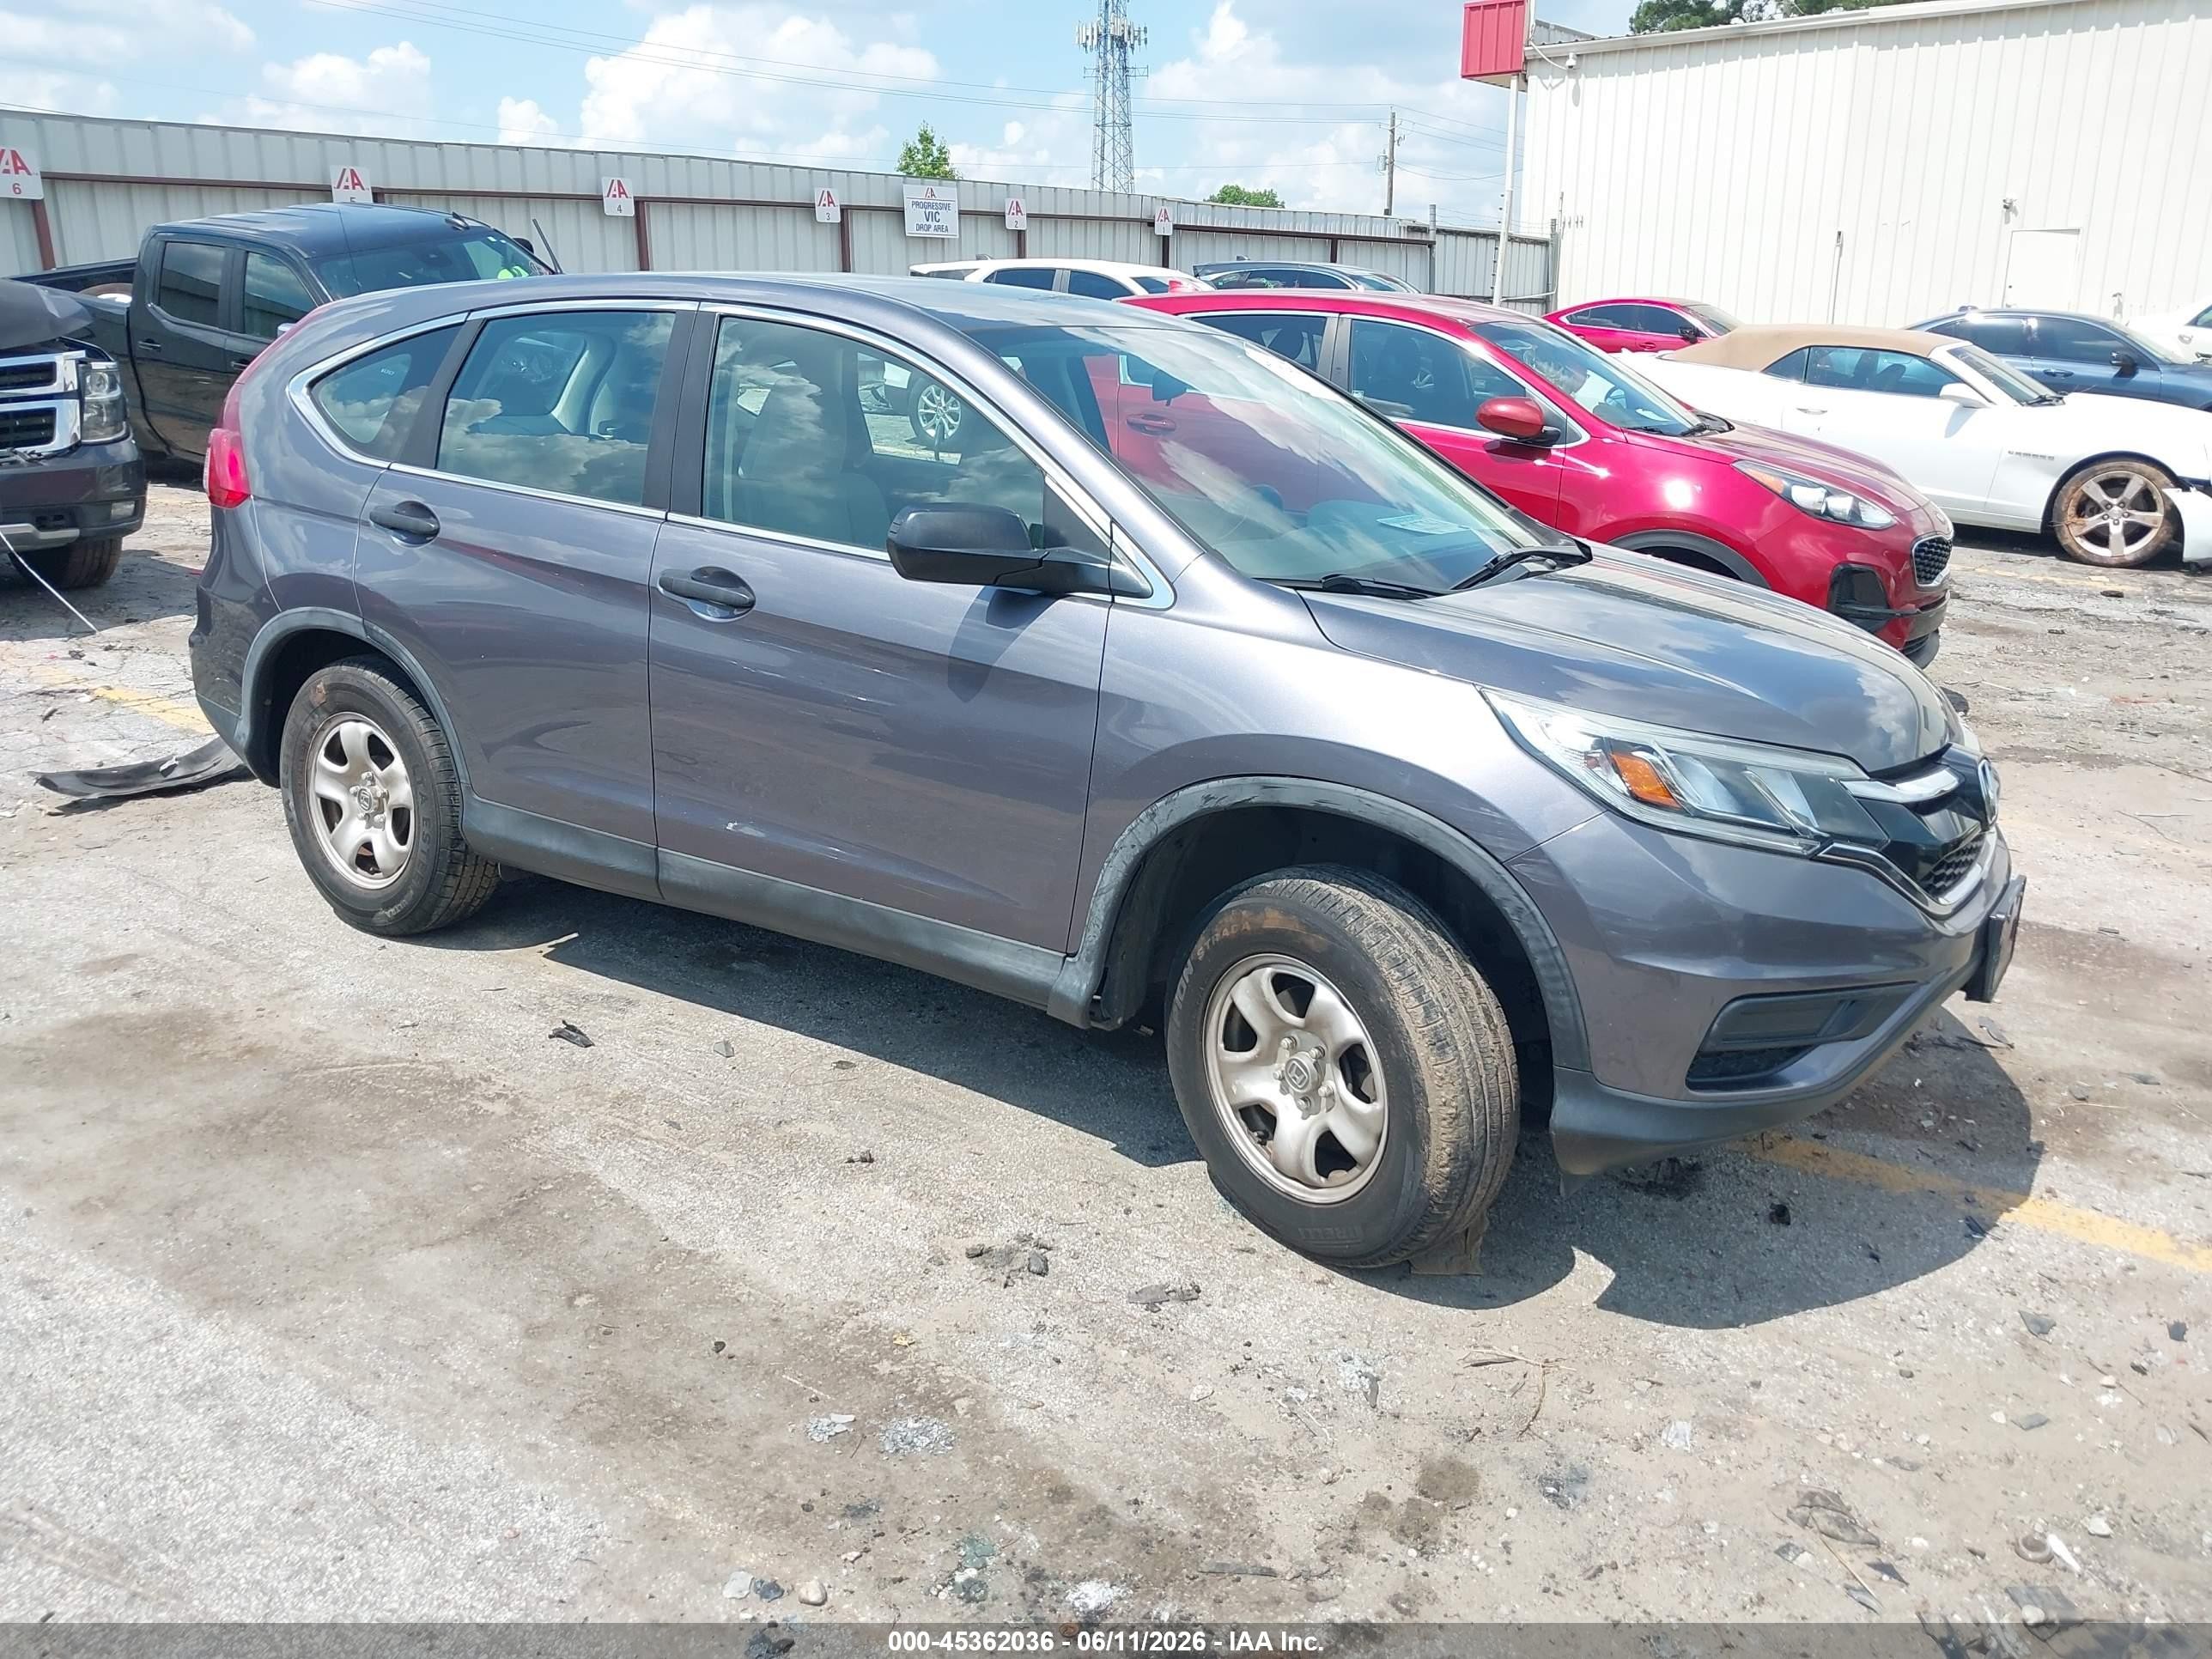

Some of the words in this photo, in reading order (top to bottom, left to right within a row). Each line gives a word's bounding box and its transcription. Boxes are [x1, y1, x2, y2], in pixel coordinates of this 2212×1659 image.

[12, 182, 21, 195] 6
[617, 204, 623, 214] 4
[911, 200, 951, 211] PROGRESSIVE
[826, 212, 831, 221] 3
[924, 210, 941, 223] VIC
[915, 223, 933, 233] DROP
[933, 224, 949, 234] AREA
[1014, 220, 1019, 228] 2
